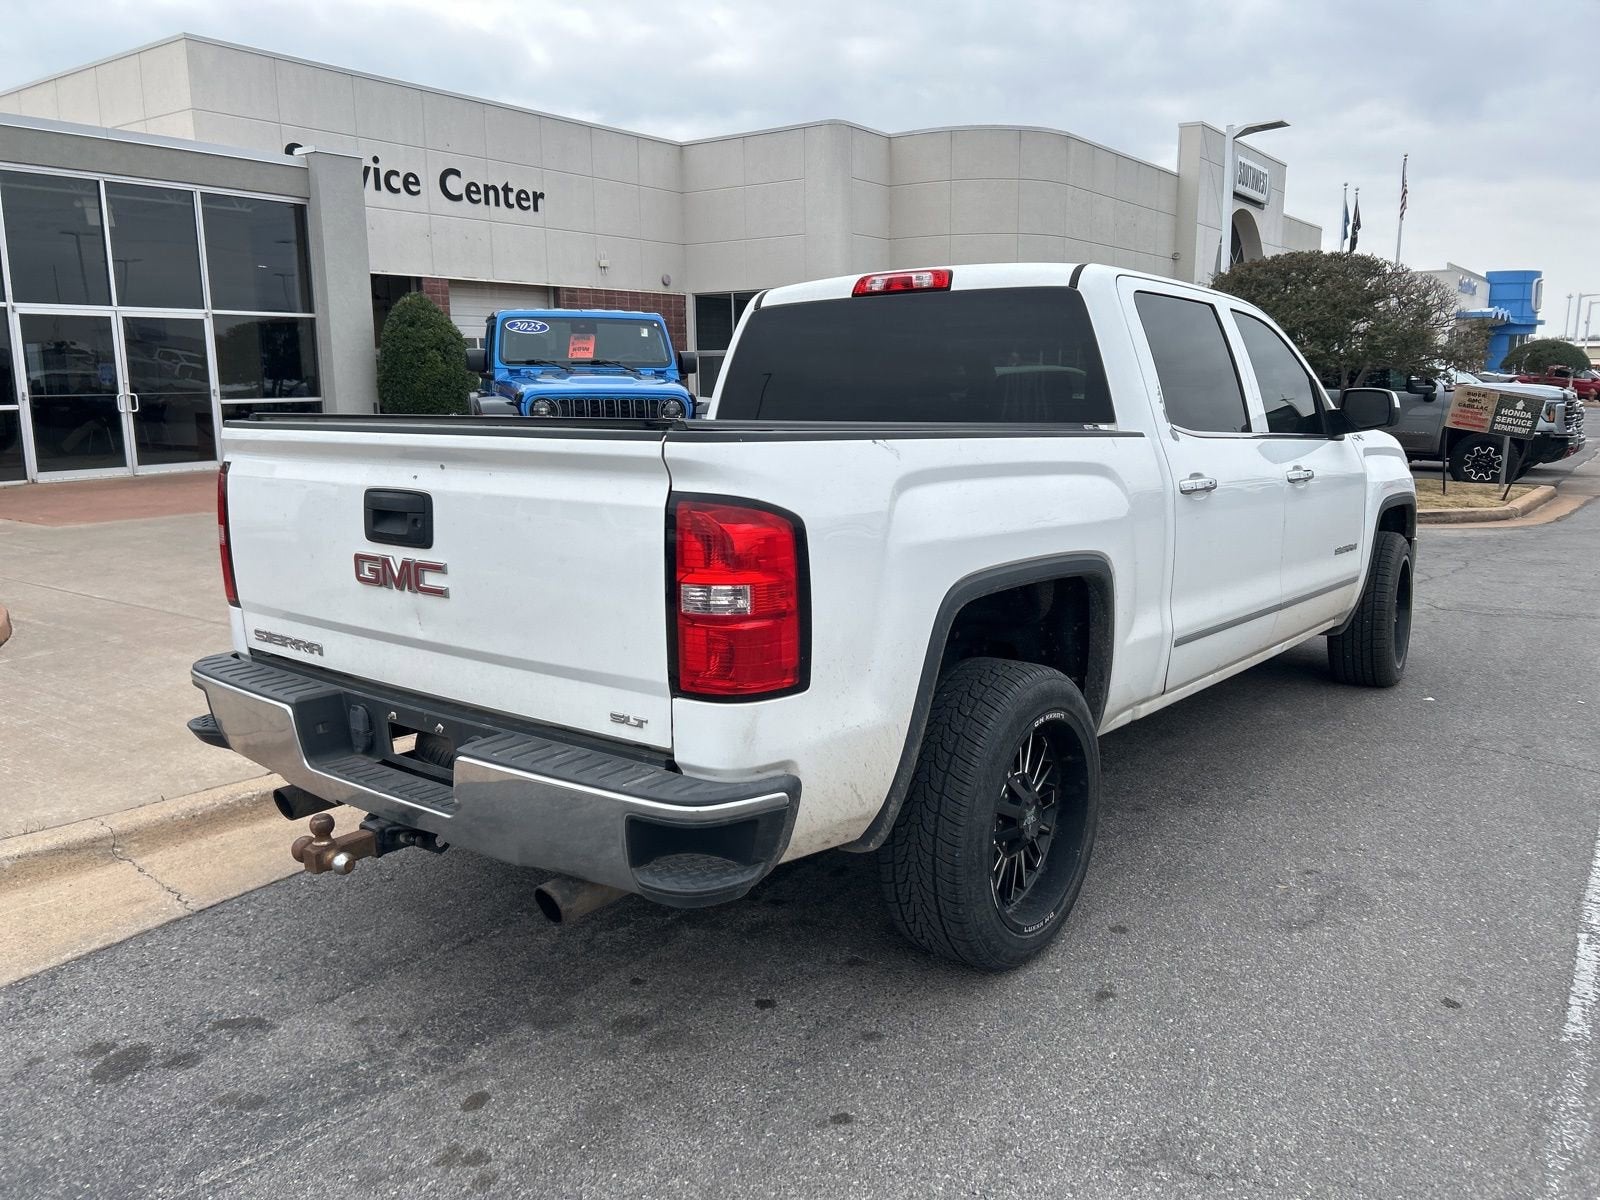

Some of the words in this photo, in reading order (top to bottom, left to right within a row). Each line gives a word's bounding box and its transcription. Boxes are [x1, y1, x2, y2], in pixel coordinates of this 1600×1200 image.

[1237, 160, 1268, 196] SOUTHWEST
[439, 167, 544, 213] Center
[512, 321, 541, 332] 2025
[1457, 402, 1489, 411] CADILLAC
[1501, 408, 1532, 419] HONDA
[1495, 415, 1533, 427] SERVICE
[1493, 423, 1530, 435] DEPARTMENT
[354, 551, 450, 599] GMC
[254, 628, 324, 657] SIERRA
[609, 712, 649, 729] SLT
